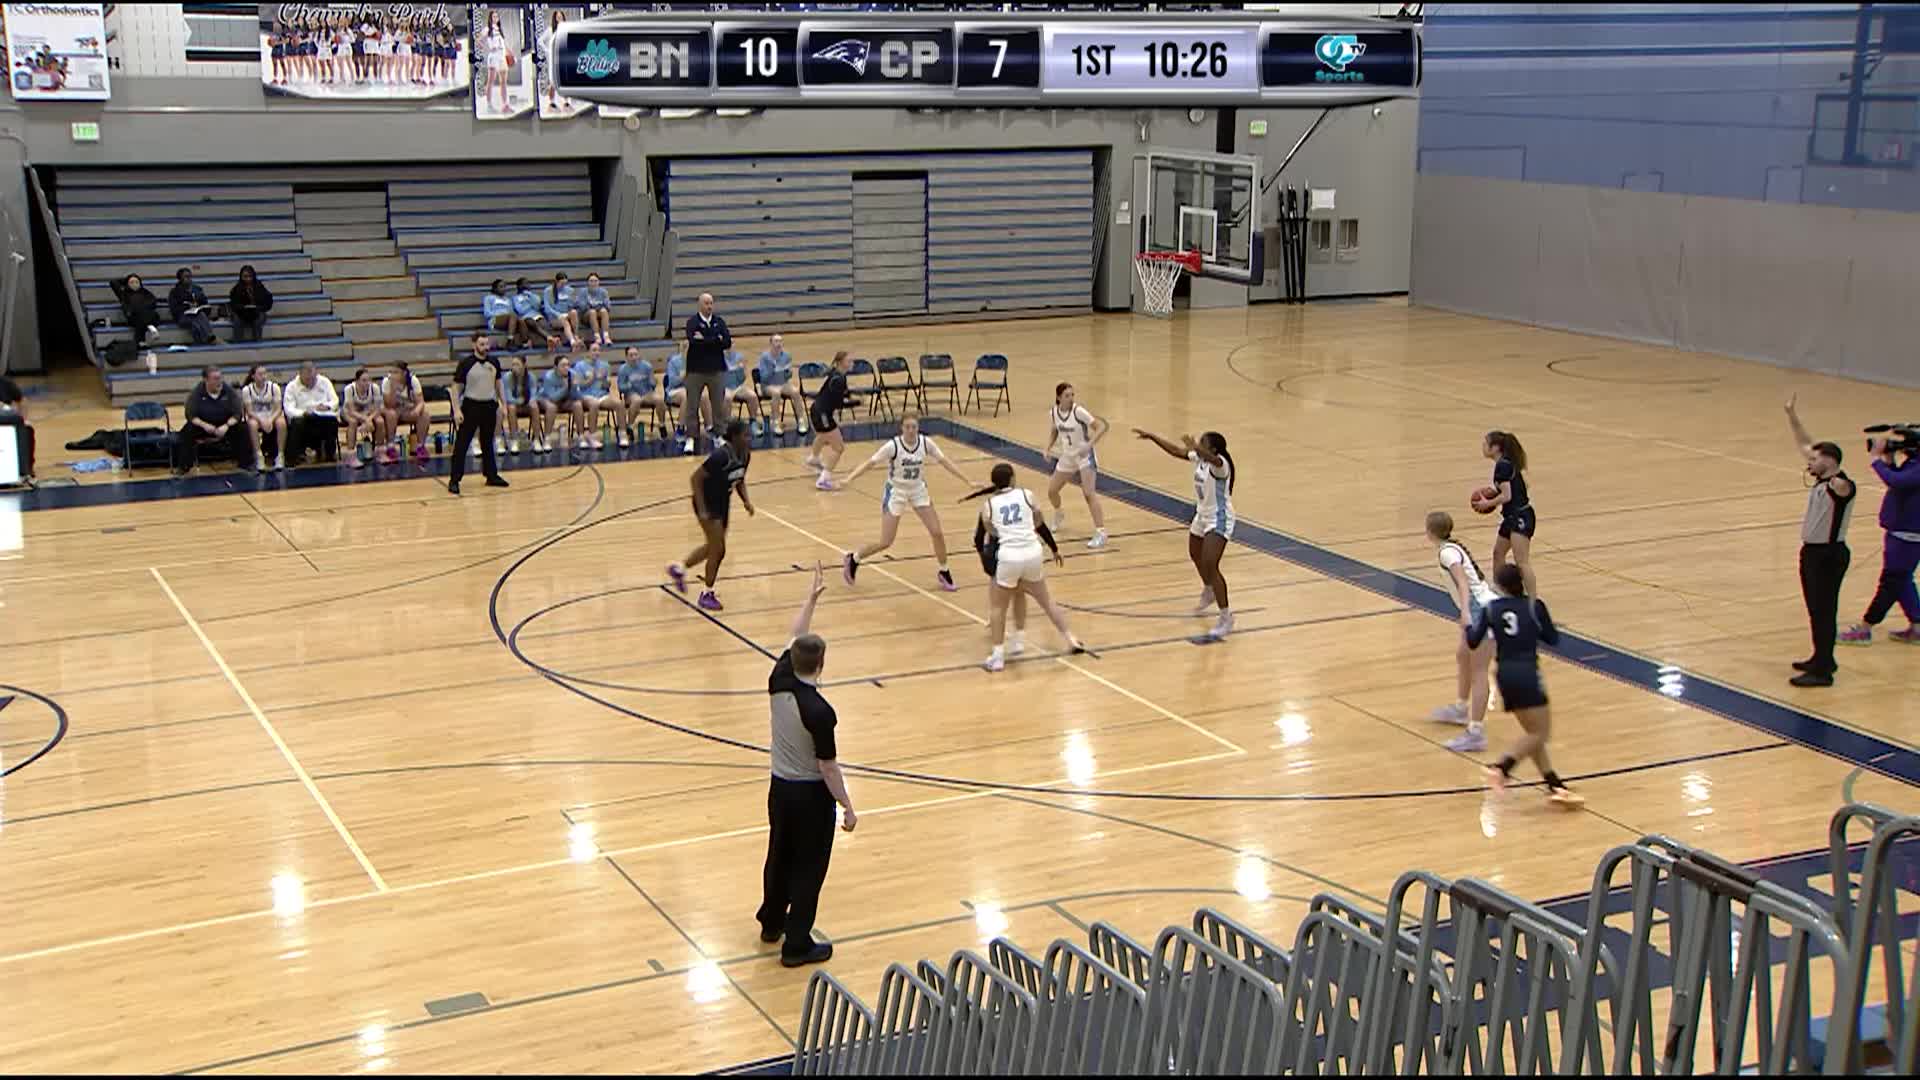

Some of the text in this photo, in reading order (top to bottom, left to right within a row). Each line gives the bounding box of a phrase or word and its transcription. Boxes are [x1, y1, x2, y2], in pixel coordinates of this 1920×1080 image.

[24, 5, 100, 16] Orthodontics
[999, 503, 1022, 526] 22
[1502, 611, 1518, 636] 3
